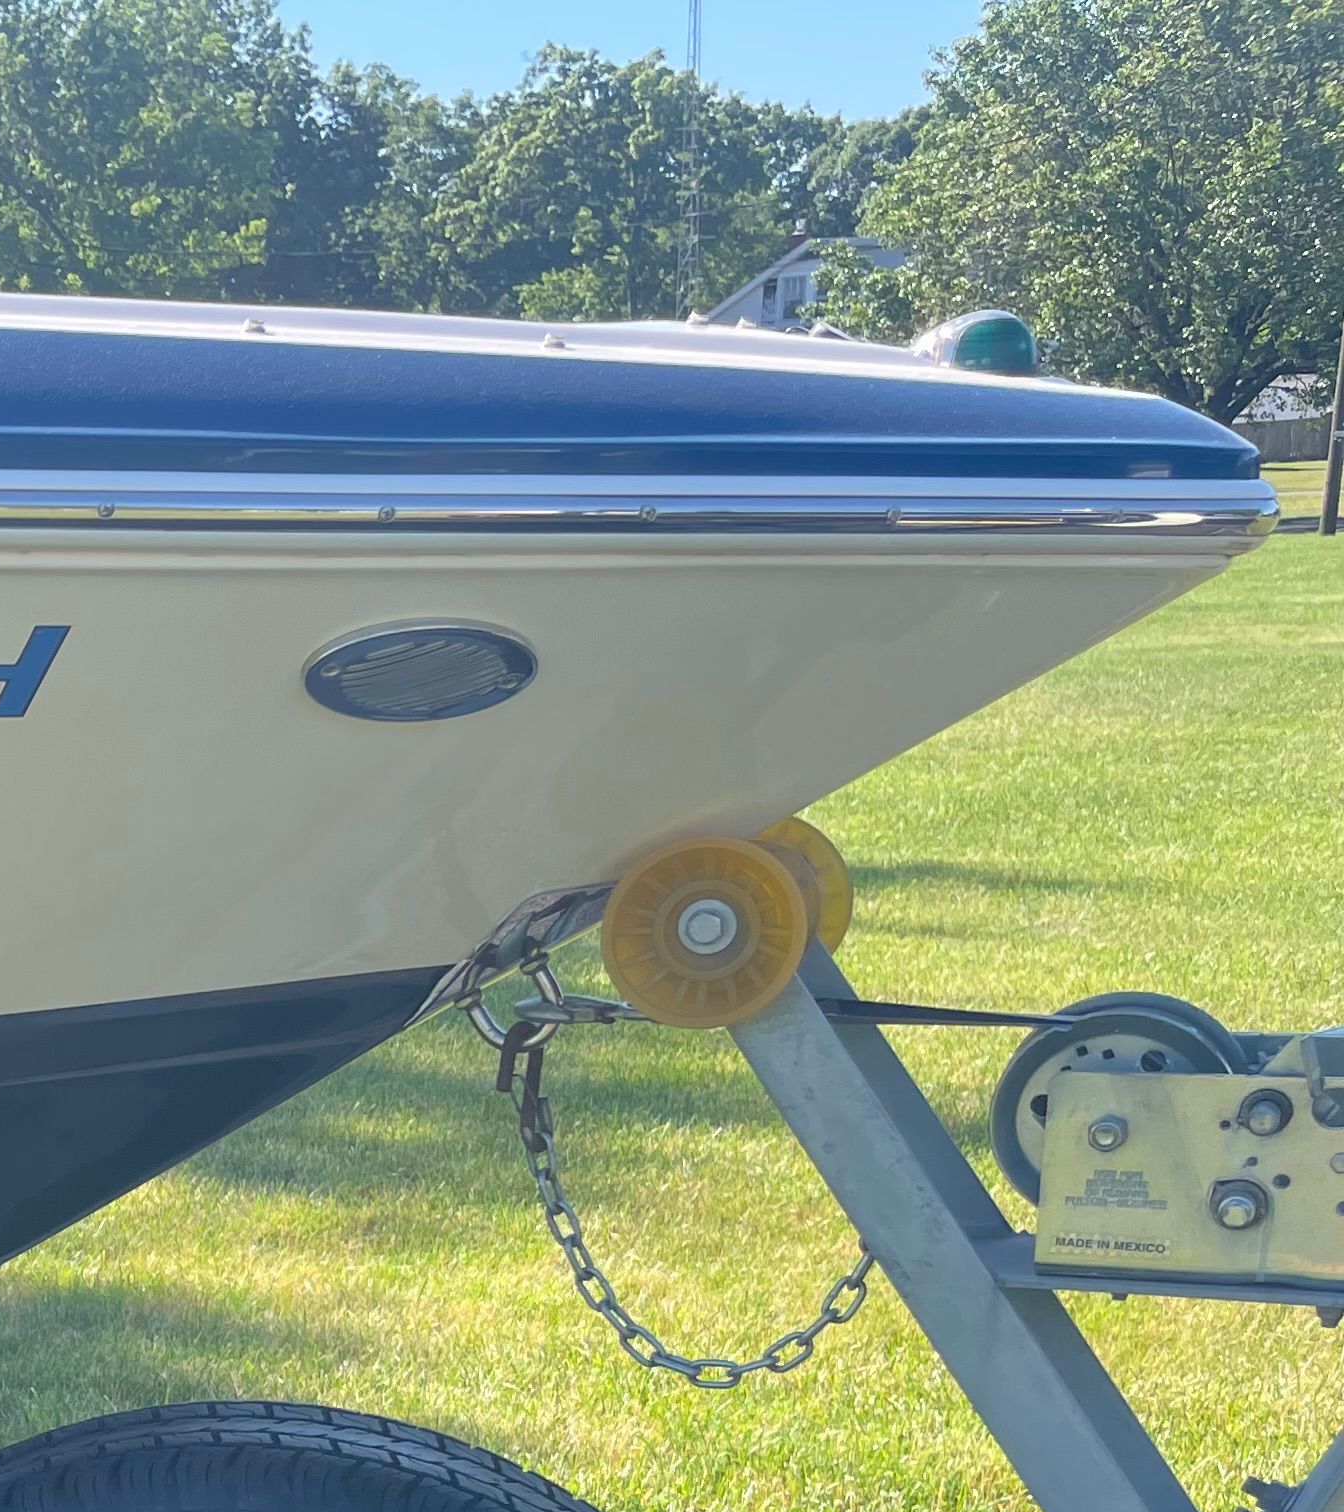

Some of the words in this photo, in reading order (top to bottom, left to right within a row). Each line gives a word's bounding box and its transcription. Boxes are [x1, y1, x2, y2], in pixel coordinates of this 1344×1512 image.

[1055, 1237, 1094, 1249] MADE
[1097, 1240, 1110, 1250] IN
[1113, 1241, 1166, 1254] MEXICO
